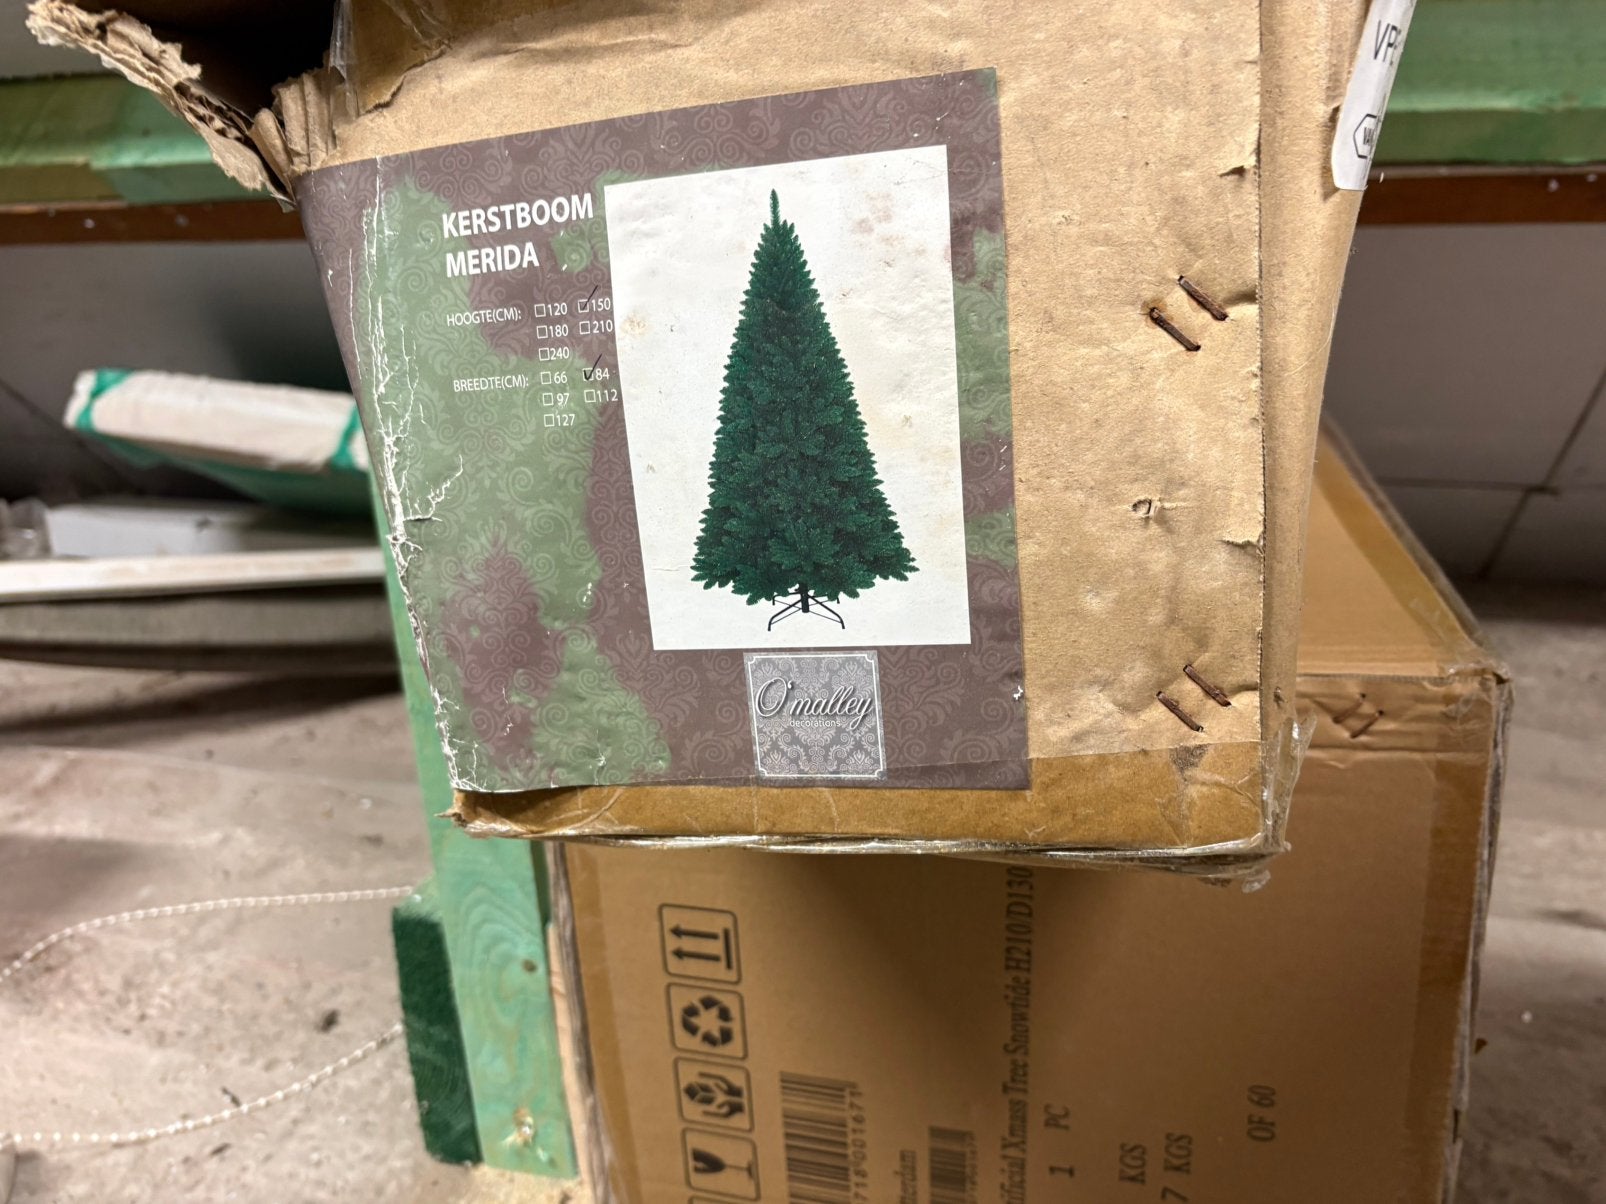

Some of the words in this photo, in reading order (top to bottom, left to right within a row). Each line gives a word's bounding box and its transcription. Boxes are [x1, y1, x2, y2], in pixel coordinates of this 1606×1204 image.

[442, 193, 594, 239] KERSTBOOM
[446, 242, 539, 278] MERIDA
[446, 307, 522, 327] HOOGTE(CM):
[547, 302, 568, 316] 120
[591, 298, 611, 312] 150
[549, 324, 569, 338] 180
[592, 320, 613, 334] 210
[550, 346, 570, 360] 240
[453, 375, 529, 392] BREEDTE(CM):
[553, 372, 567, 384] 66
[595, 368, 610, 380] 84
[556, 393, 570, 405] 97
[596, 390, 618, 402] 112
[556, 414, 575, 426] 127
[790, 718, 841, 728] decorations
[1004, 865, 1035, 972] H210/D130
[1001, 1057, 1029, 1096] Tree
[1247, 1084, 1276, 1108] 60
[1001, 1099, 1029, 1152] Xmass
[1044, 1104, 1070, 1131] PC
[1246, 1112, 1276, 1142] OF
[1119, 1141, 1147, 1185] KGS
[1164, 1131, 1193, 1175] KGS
[1049, 1164, 1075, 1178] 1
